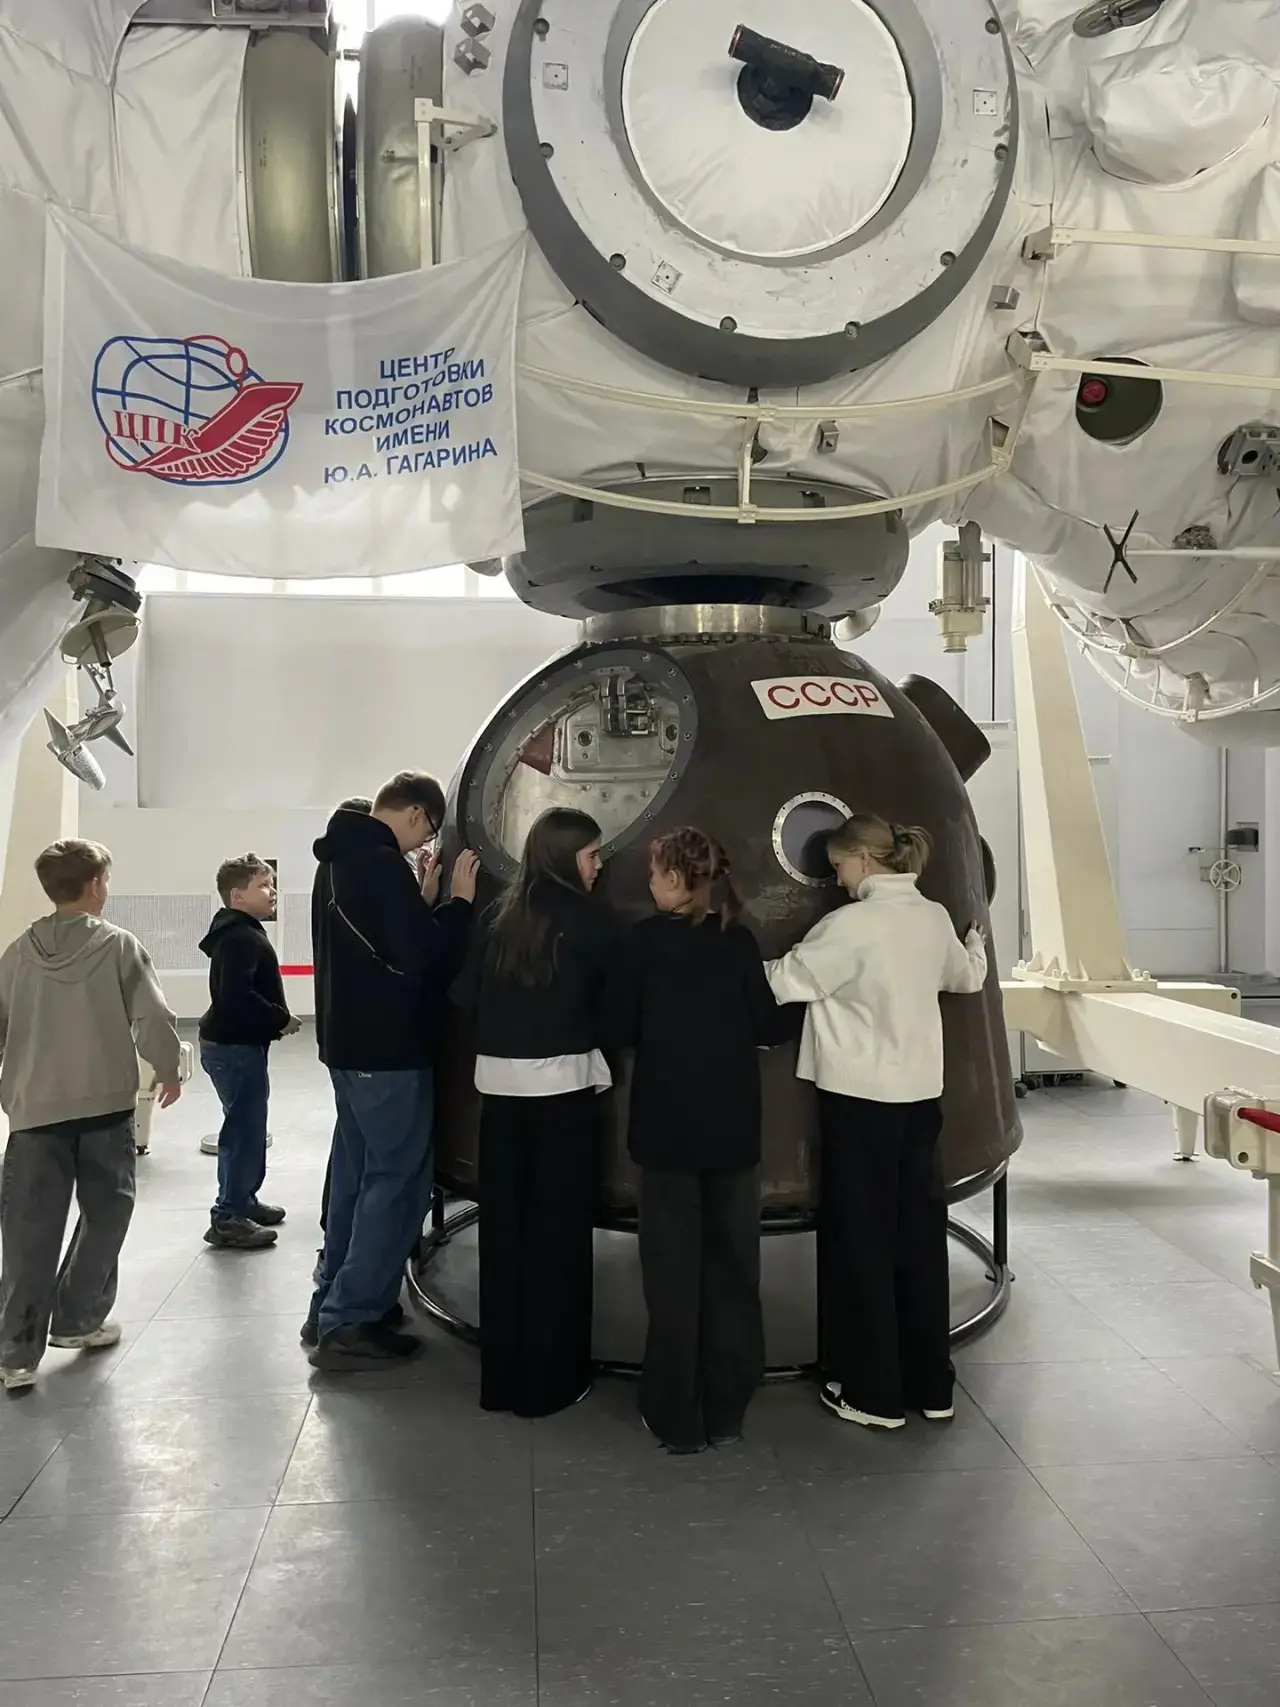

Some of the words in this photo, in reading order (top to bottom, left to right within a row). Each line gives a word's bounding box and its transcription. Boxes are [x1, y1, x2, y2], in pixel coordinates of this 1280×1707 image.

[336, 359, 485, 410] ПОДГОТОВКИ
[379, 347, 455, 382] ЦЕНТР
[325, 383, 493, 435] КОСМОНАВТОВ
[112, 410, 201, 453] ЦПК
[376, 420, 450, 453] ИМЕНИ
[324, 463, 378, 484] Ю.А.
[386, 437, 498, 475] ГАГАРИНА
[767, 681, 879, 709] СССР
